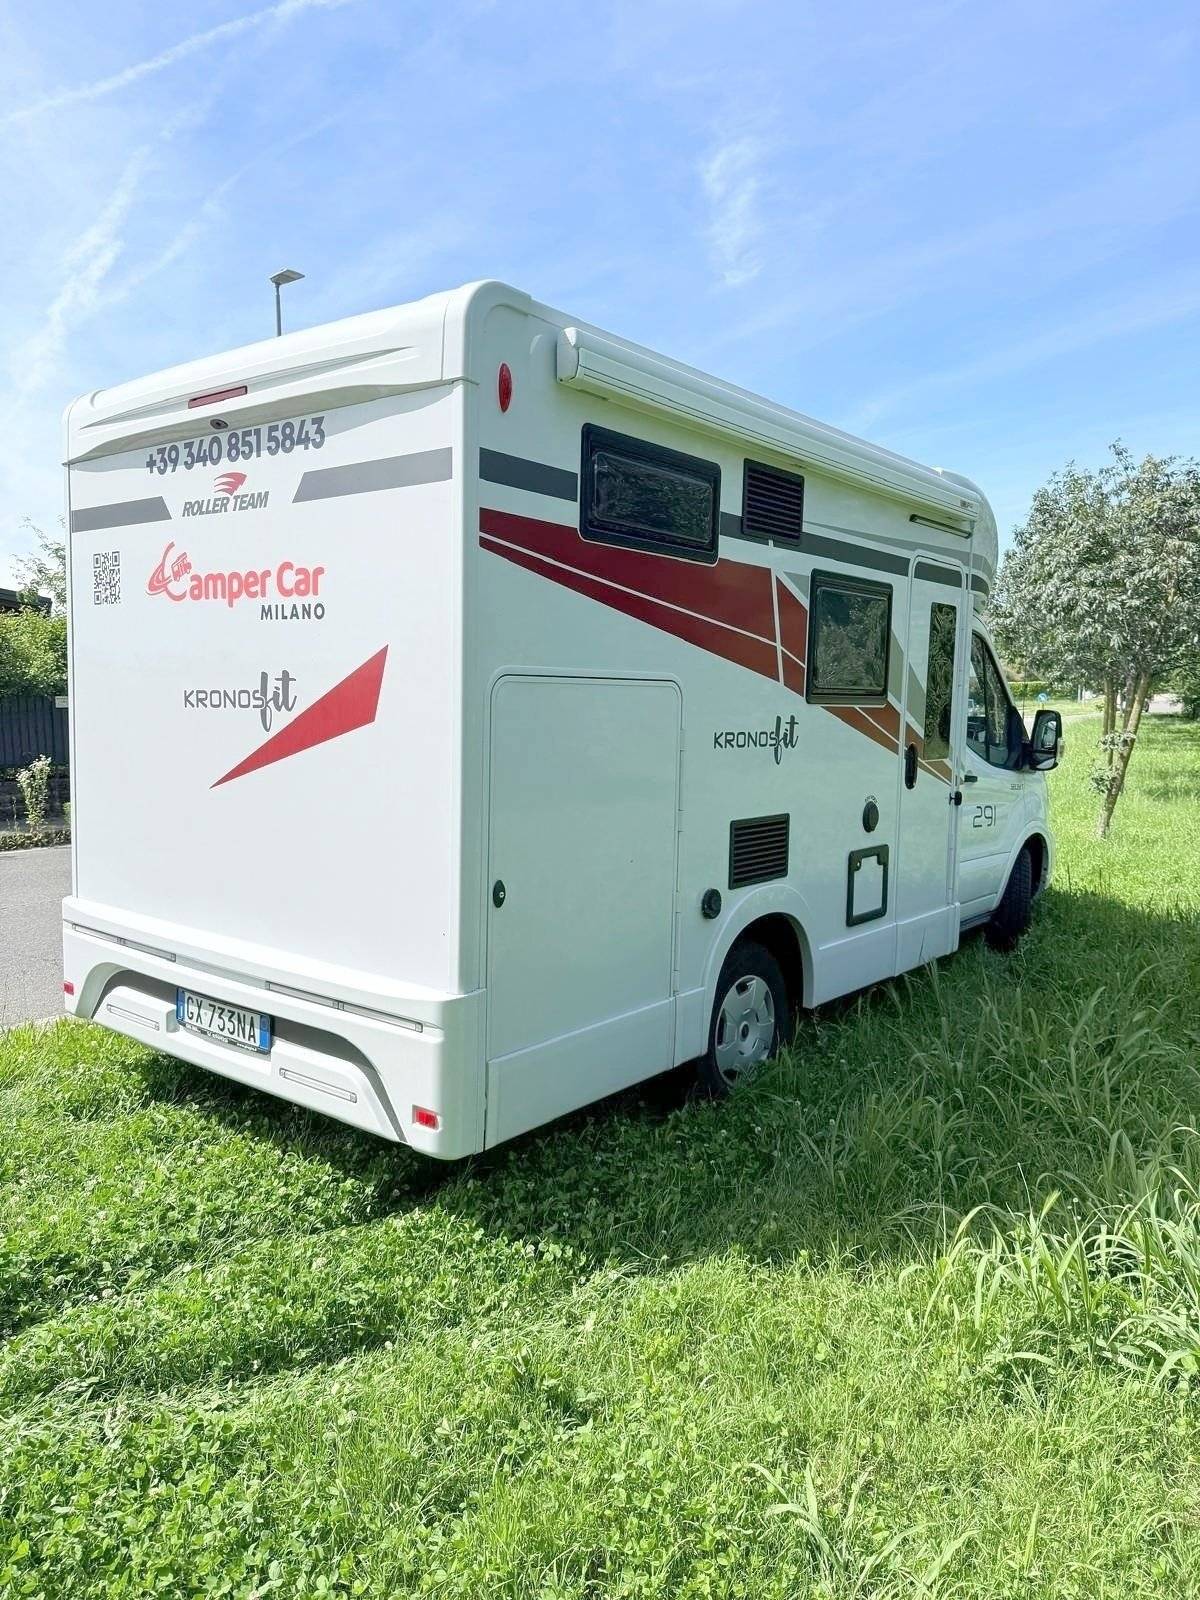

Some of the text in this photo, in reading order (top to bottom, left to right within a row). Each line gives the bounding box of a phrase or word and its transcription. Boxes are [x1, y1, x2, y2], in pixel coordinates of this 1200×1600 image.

[146, 416, 326, 475] +39 340 851 5843
[182, 490, 270, 517] ROLLER TEAM
[277, 561, 325, 598] Car
[260, 603, 326, 621] MILANO
[972, 805, 997, 829] 291
[186, 996, 257, 1044] GX 733NA
